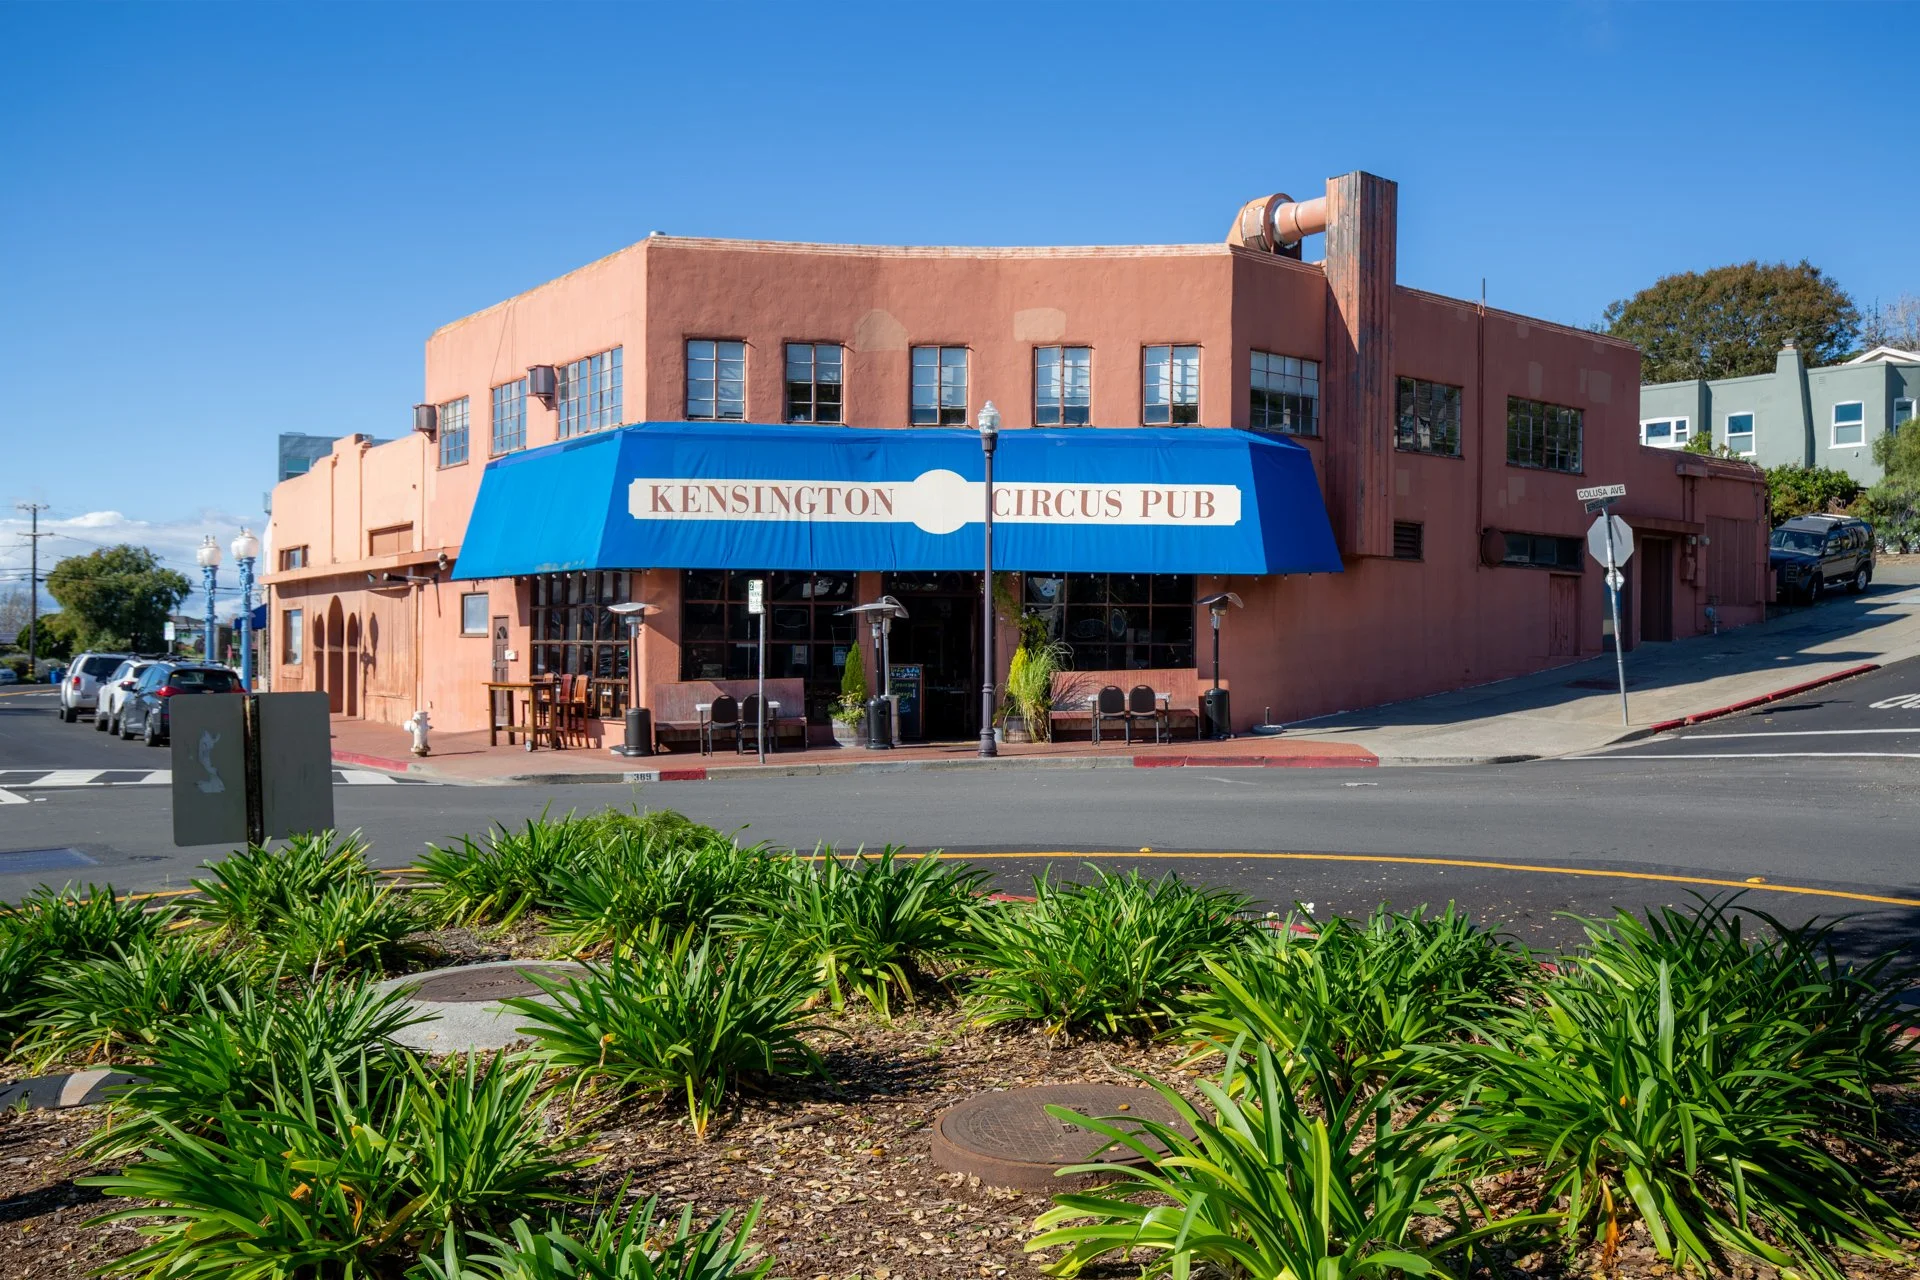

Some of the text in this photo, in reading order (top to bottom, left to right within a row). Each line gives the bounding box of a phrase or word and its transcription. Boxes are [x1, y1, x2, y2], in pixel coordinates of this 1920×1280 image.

[1578, 486, 1625, 498] COLUSA AVE
[648, 485, 1215, 519] KENSINGTON CIRCUS PUB
[633, 773, 651, 781] 389
